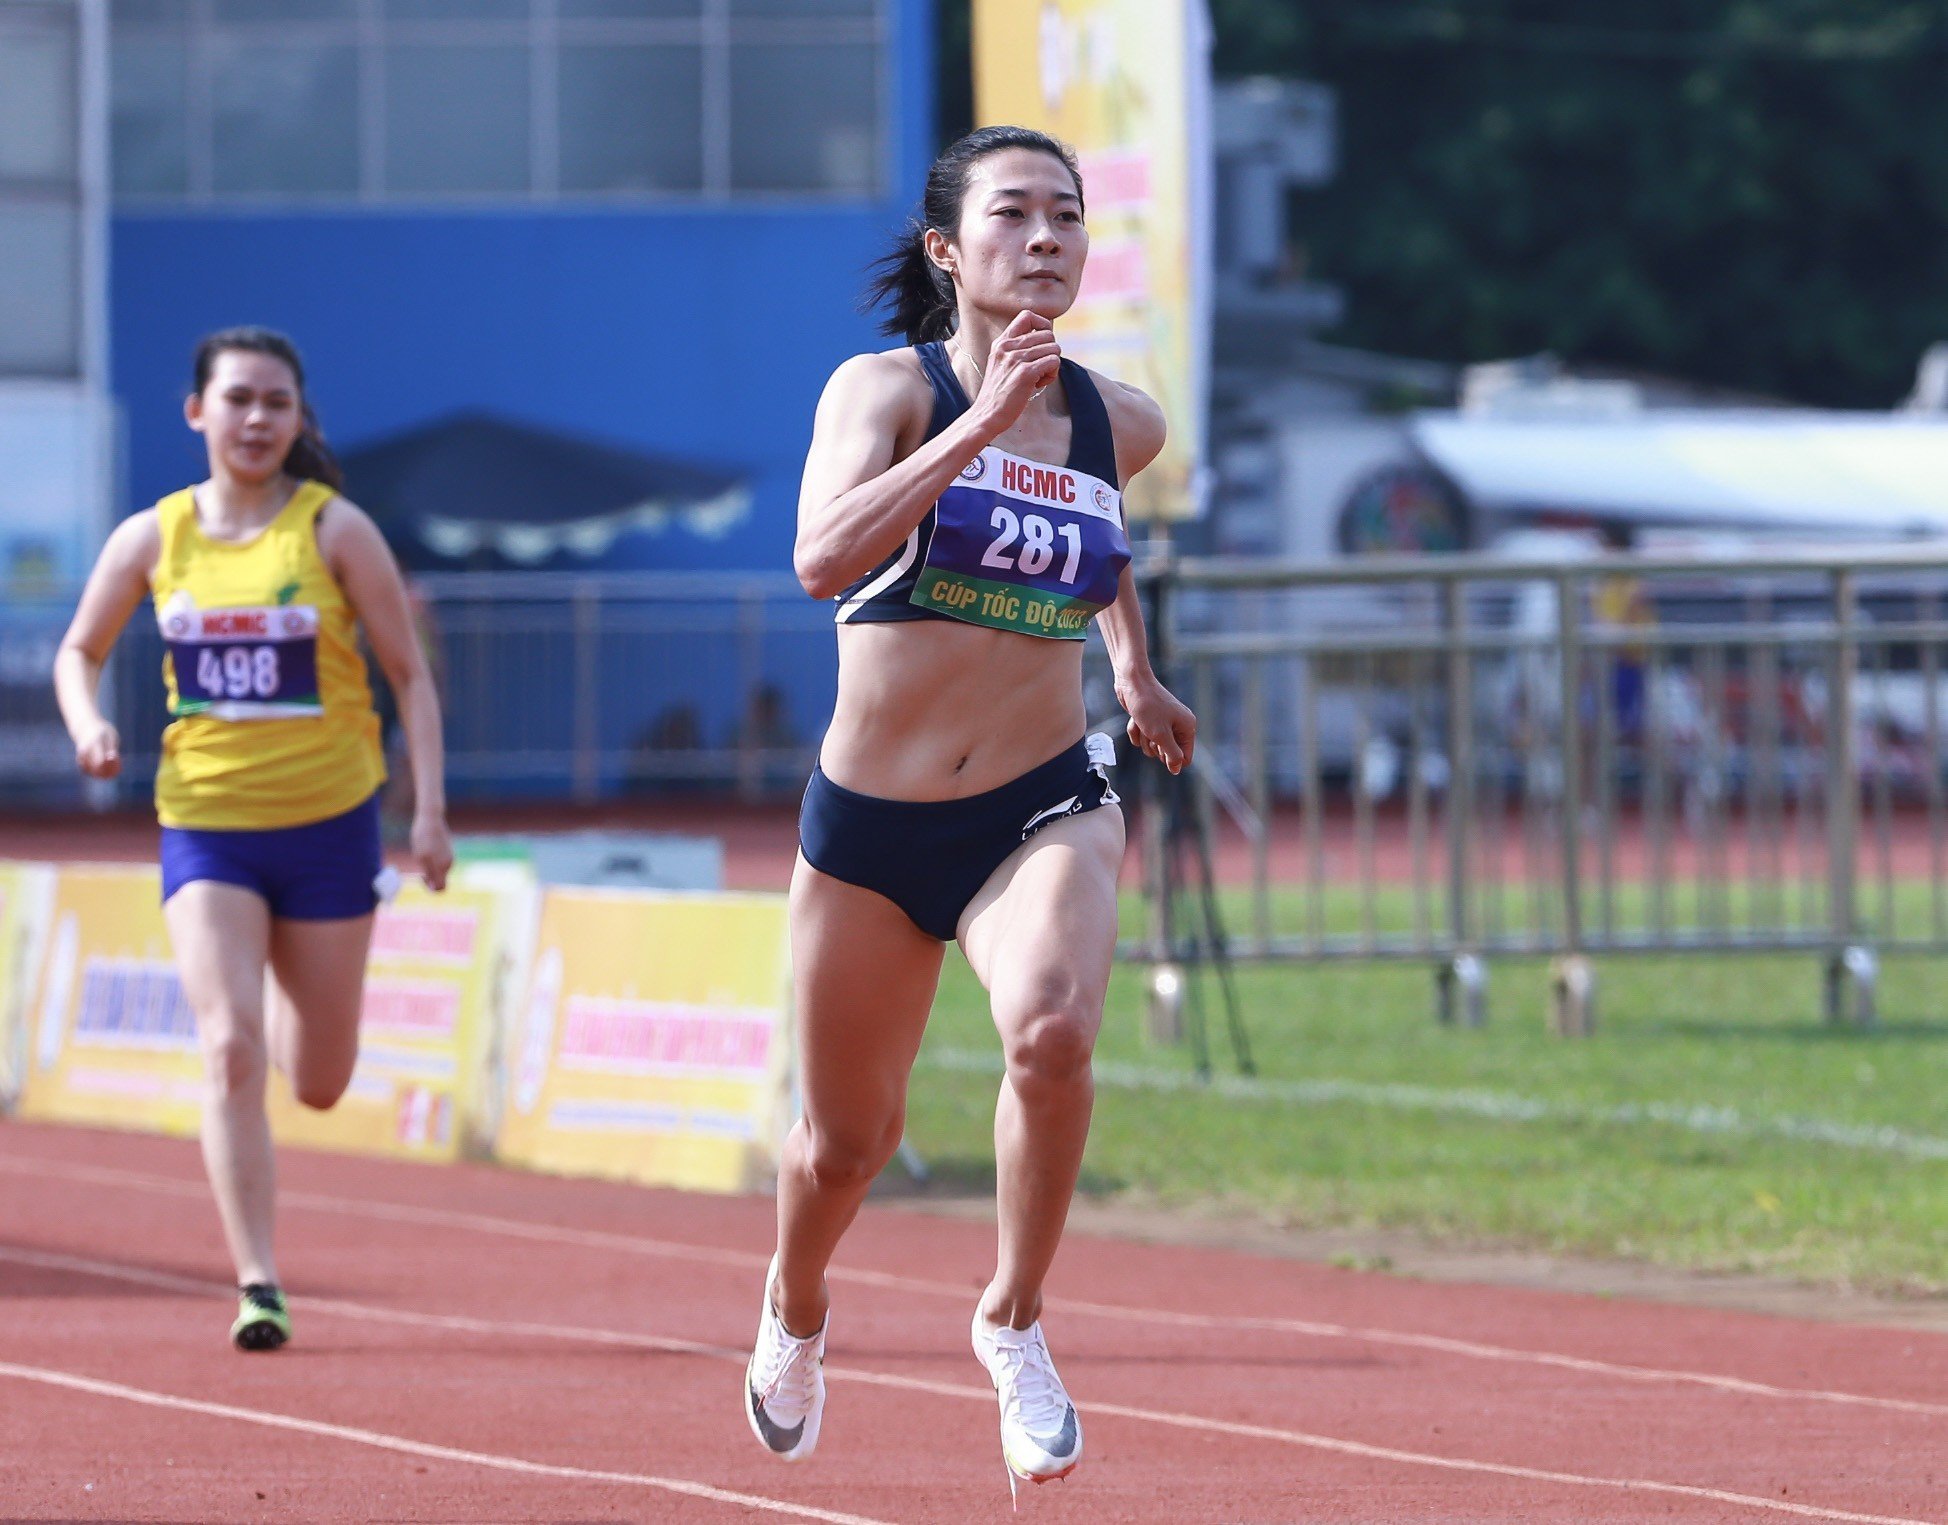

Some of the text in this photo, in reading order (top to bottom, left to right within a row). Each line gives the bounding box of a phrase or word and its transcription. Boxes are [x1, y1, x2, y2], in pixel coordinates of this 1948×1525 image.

[1002, 459, 1076, 503] HCMC
[980, 506, 1082, 585] 281
[931, 580, 978, 610] CÚP
[981, 587, 1020, 621] TỐC
[1025, 600, 1057, 632] ĐỘ
[196, 645, 281, 698] 498
